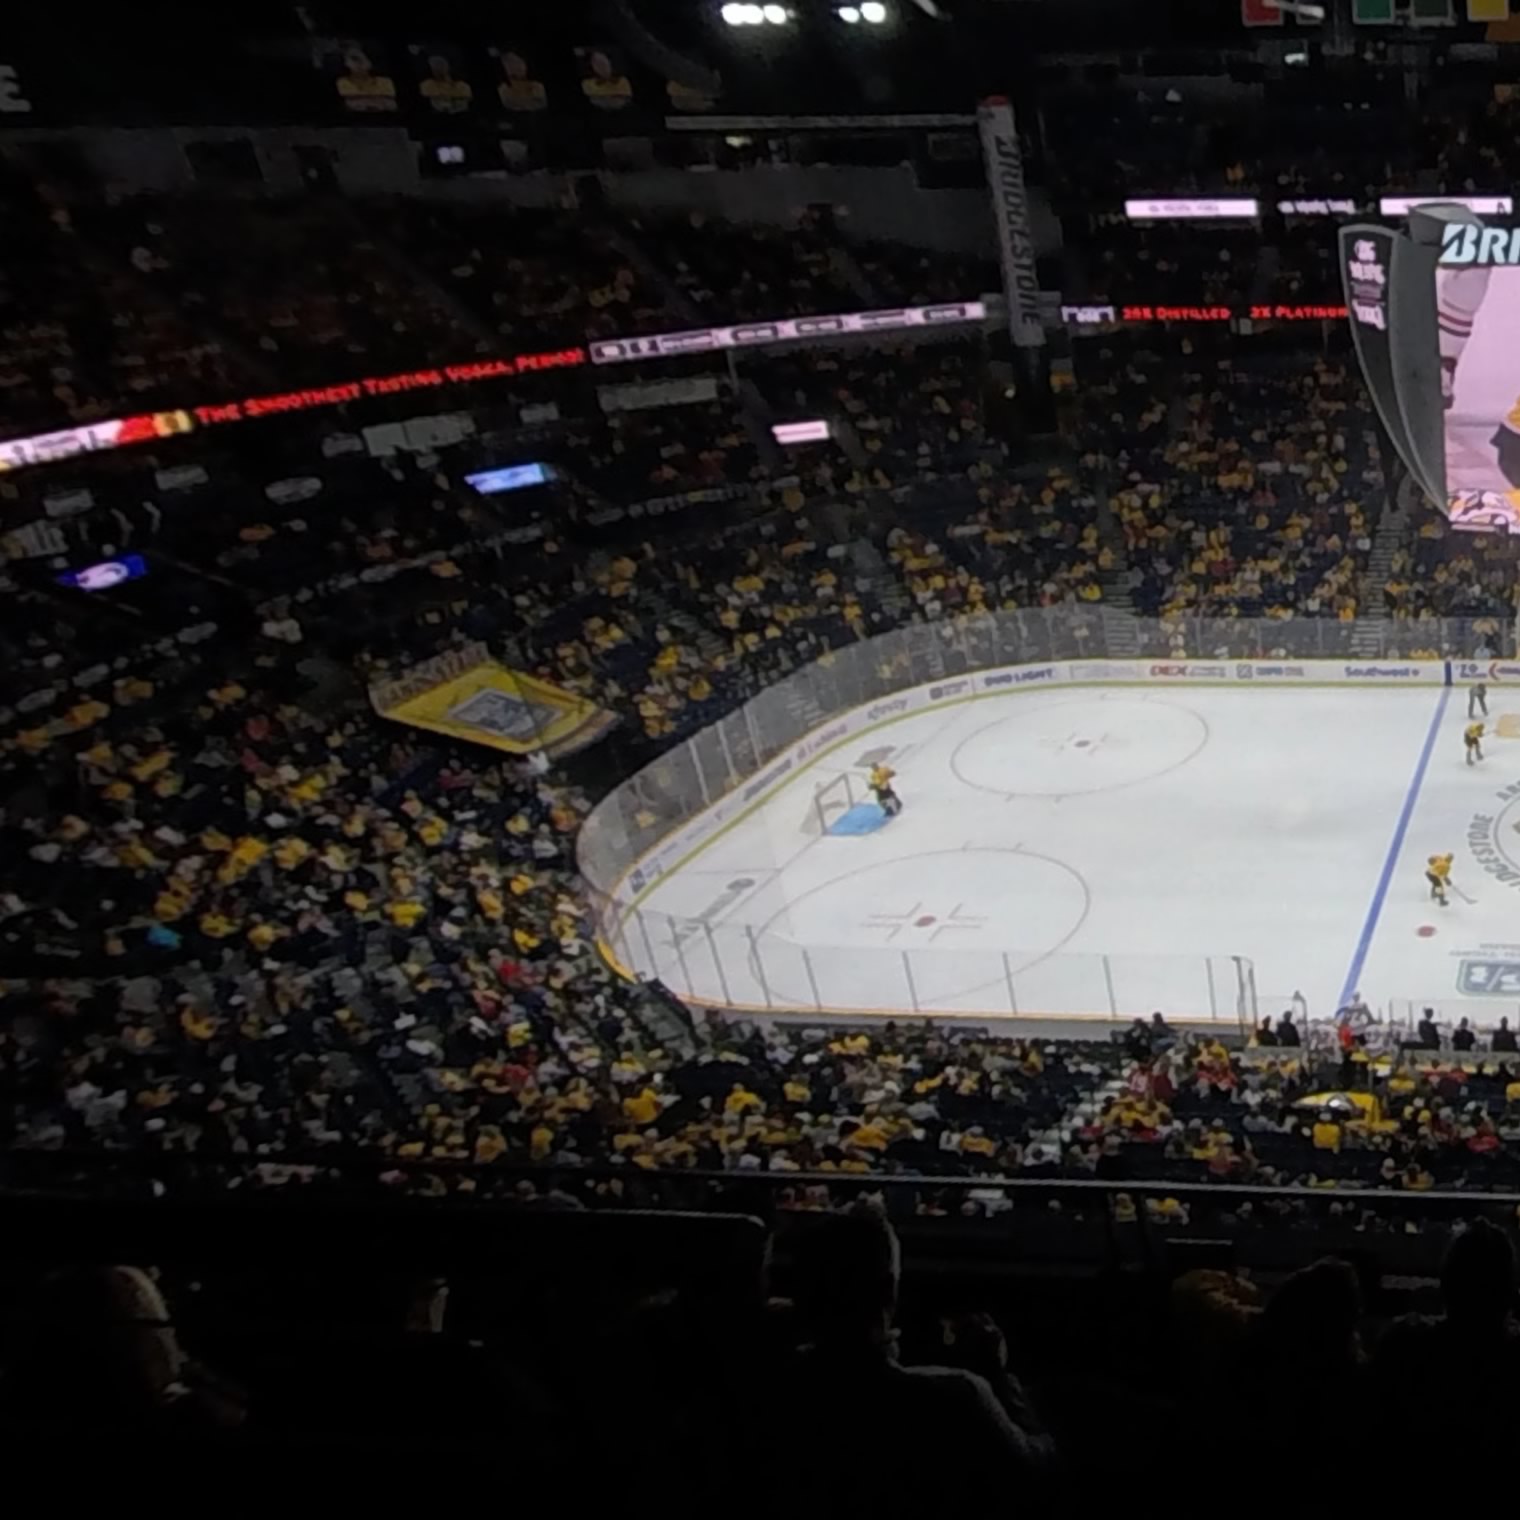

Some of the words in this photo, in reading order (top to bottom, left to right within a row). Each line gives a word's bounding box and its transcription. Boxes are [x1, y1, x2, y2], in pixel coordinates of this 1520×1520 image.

[993, 133, 1042, 326] BRIDGESTONE
[194, 404, 242, 425] THE
[245, 383, 362, 417] SMOOTHEST
[363, 369, 443, 396] TASTING
[1015, 667, 1054, 682] LIGHT
[1151, 664, 1187, 677] DEX
[1344, 665, 1411, 678] Southwest
